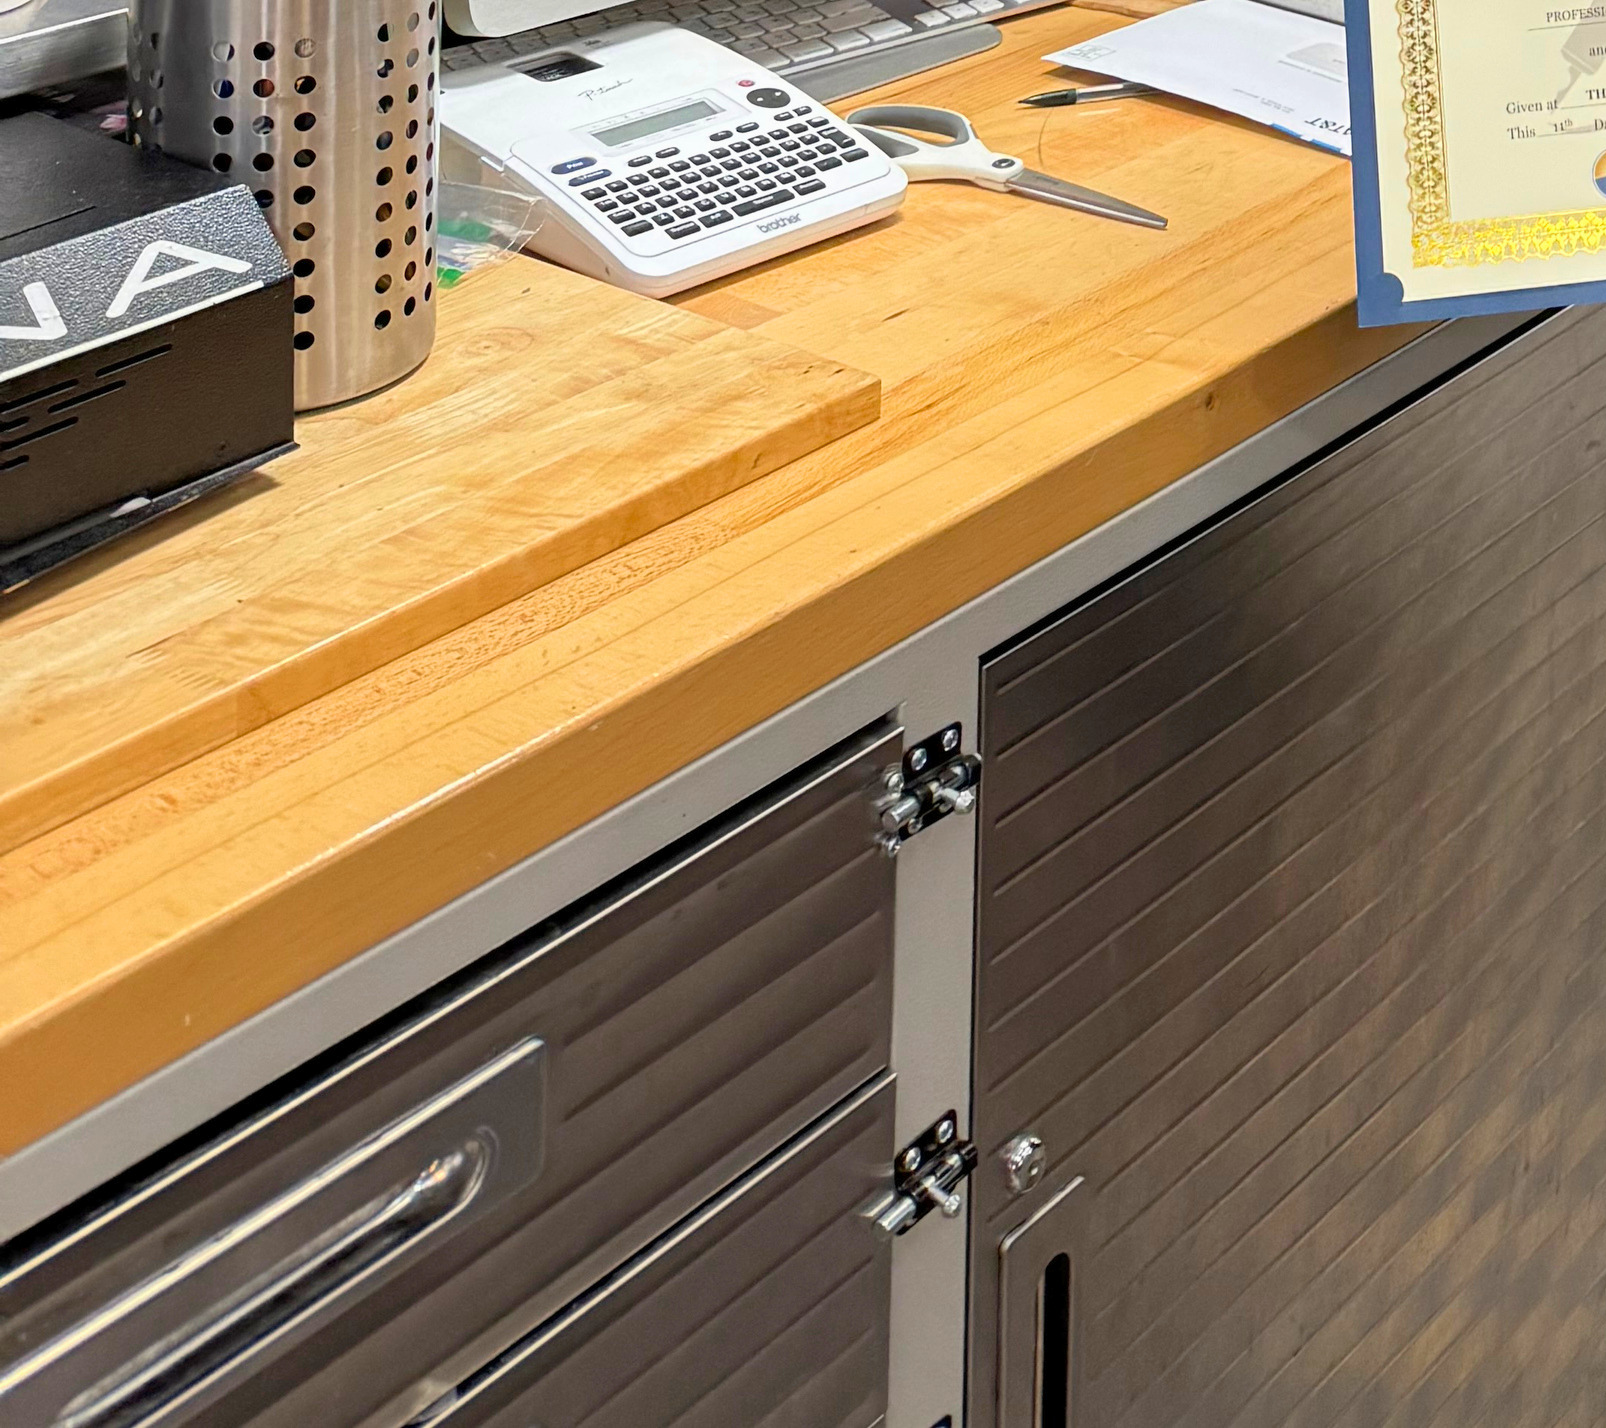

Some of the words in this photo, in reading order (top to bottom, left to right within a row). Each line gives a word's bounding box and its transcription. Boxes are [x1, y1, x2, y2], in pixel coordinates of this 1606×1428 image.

[1506, 101, 1543, 115] Given
[1546, 99, 1558, 111] at
[1506, 125, 1536, 140] This
[1553, 118, 1573, 133] 11th
[756, 212, 802, 234] brother
